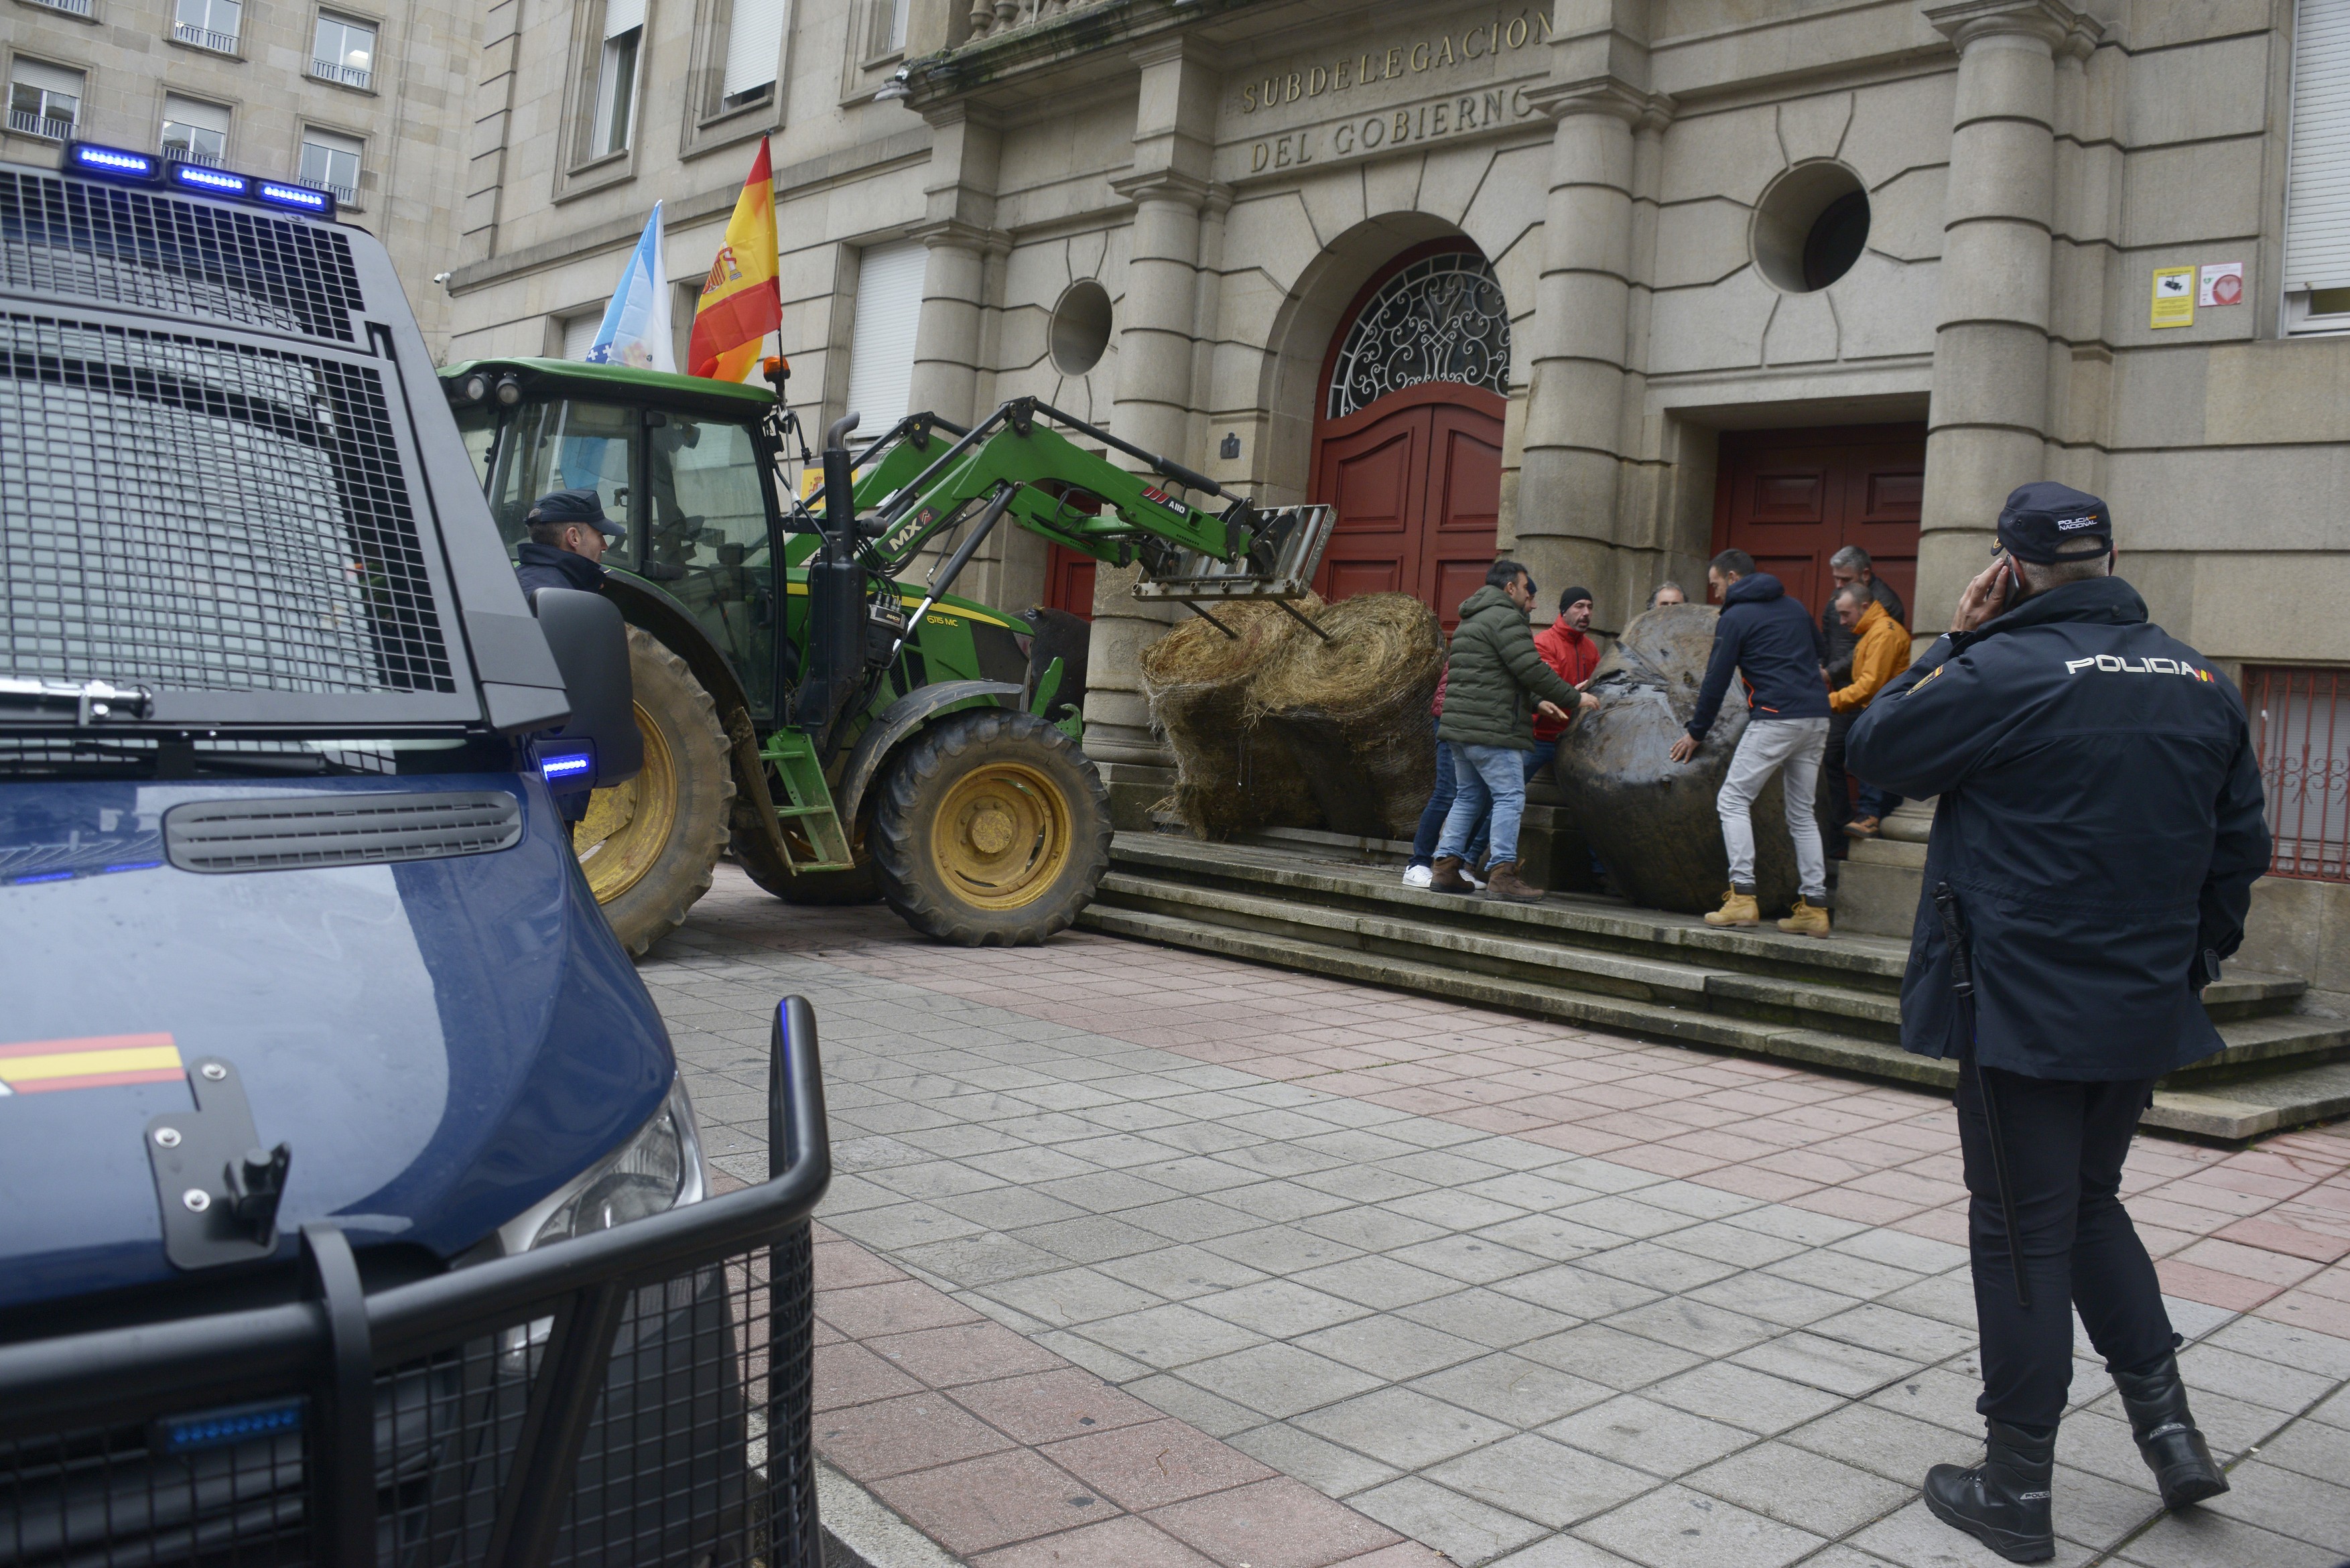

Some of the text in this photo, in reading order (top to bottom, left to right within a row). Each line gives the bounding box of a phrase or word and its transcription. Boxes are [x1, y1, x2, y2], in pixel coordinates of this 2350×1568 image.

[1243, 9, 1553, 113] SUBDELEGACIÓN
[1251, 133, 1312, 174] DEL
[889, 517, 922, 551] MX
[2058, 517, 2089, 526] POLICIA
[2059, 520, 2097, 531] NACIONAL
[927, 615, 958, 627] 6115 MC
[2065, 654, 2199, 679] POLICIA
